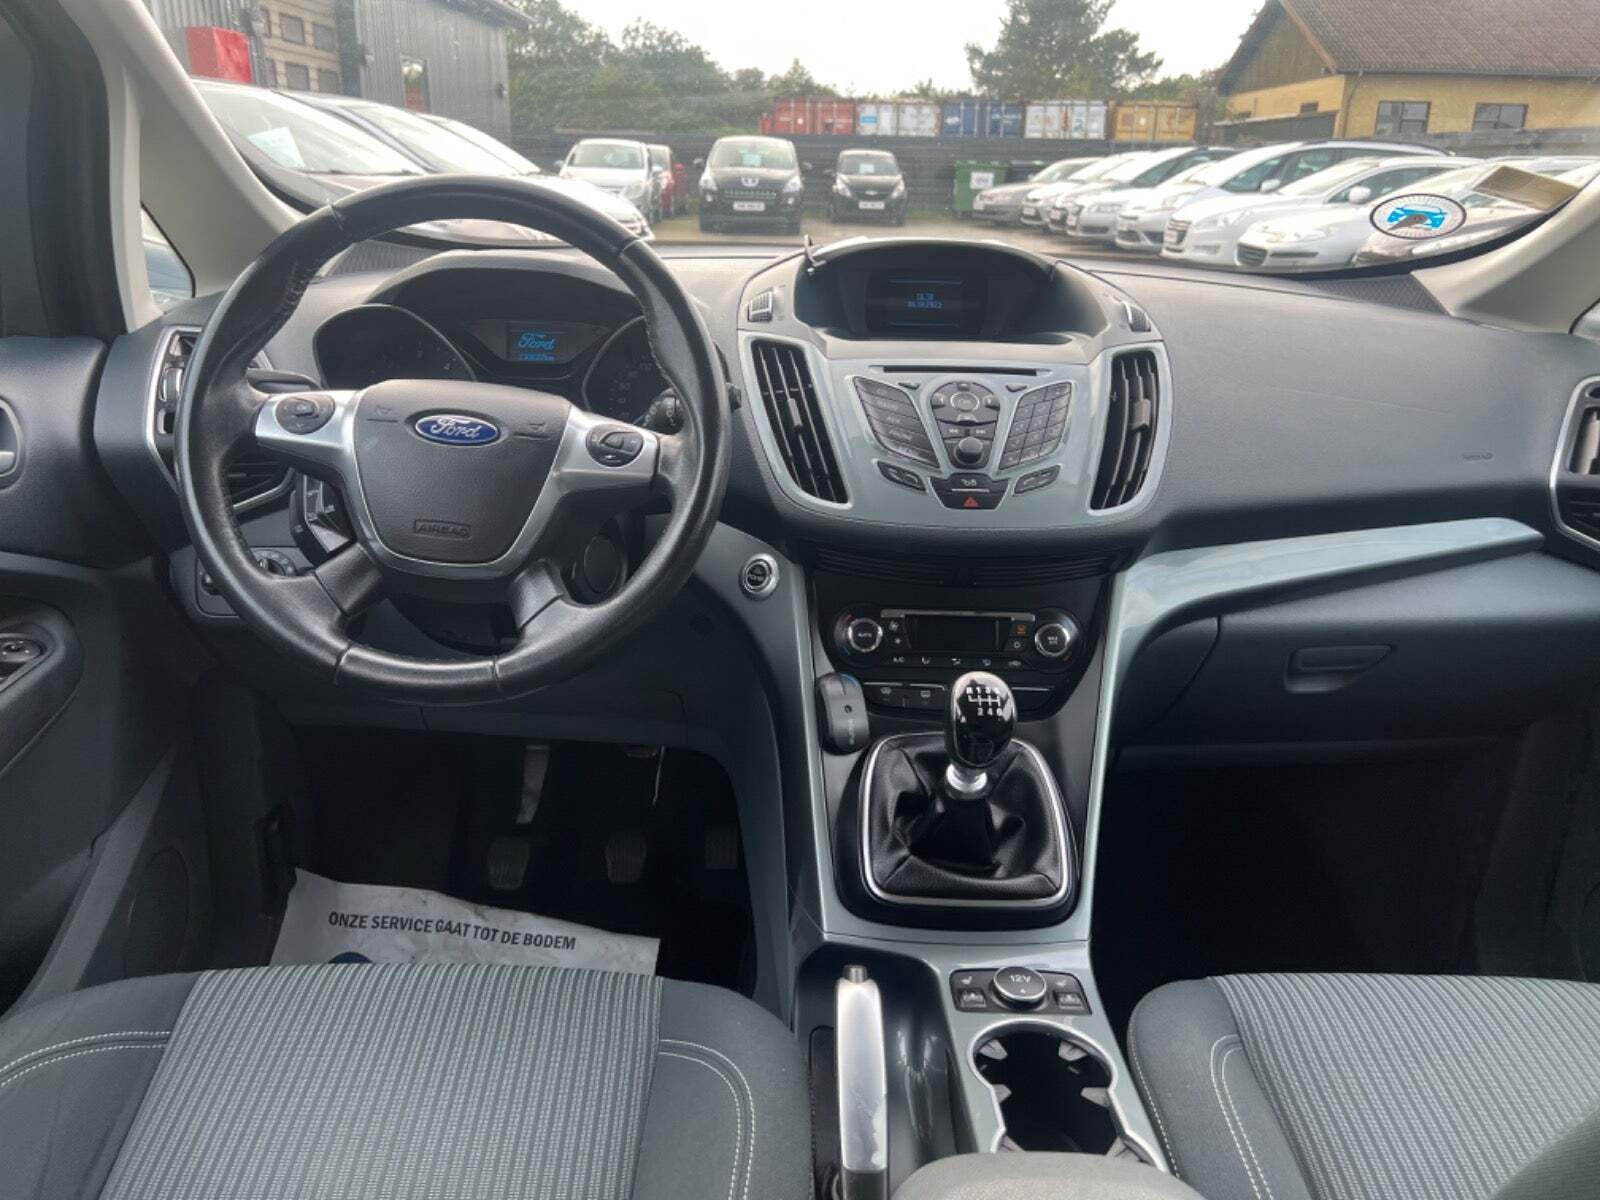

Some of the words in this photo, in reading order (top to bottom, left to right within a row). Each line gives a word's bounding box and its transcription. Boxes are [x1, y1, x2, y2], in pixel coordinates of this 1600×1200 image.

[518, 331, 557, 351] Ford
[430, 418, 482, 438] Ford
[418, 524, 469, 537] AIRBAG
[328, 911, 369, 929] ONZE
[370, 915, 433, 933] SERVICE
[435, 919, 472, 938] GAAT
[473, 923, 500, 942] TOT
[500, 930, 521, 945] DE
[522, 932, 577, 950] BODEM
[1009, 974, 1032, 983] 12V
